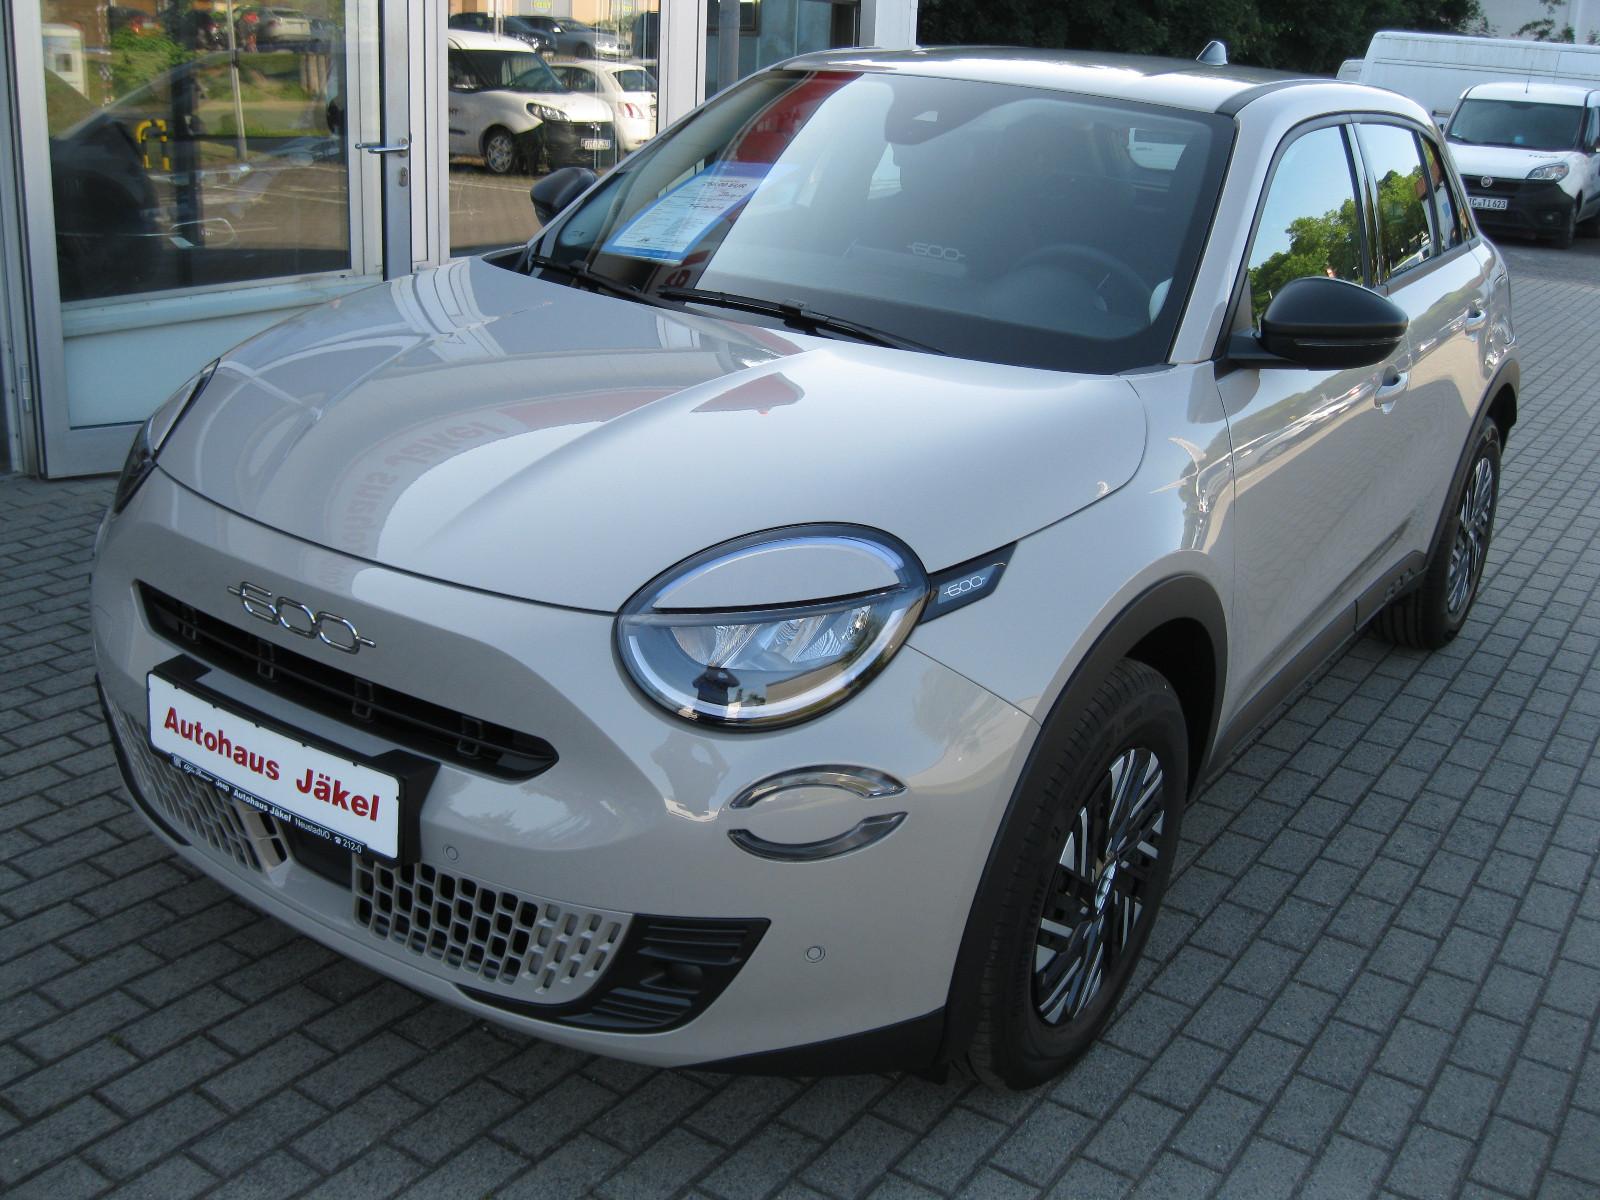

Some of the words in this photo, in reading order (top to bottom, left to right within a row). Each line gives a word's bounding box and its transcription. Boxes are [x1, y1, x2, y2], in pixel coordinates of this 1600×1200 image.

[1492, 200, 1506, 208] 623
[905, 242, 966, 260] 600
[944, 575, 985, 597] 600
[227, 581, 376, 655] 600
[164, 706, 280, 780] Autohaus
[296, 768, 380, 822] Jäkel
[215, 779, 230, 792] Jeep
[233, 789, 268, 812] Autohaus
[269, 807, 291, 823] Jäkel
[342, 839, 362, 854] 212-0
